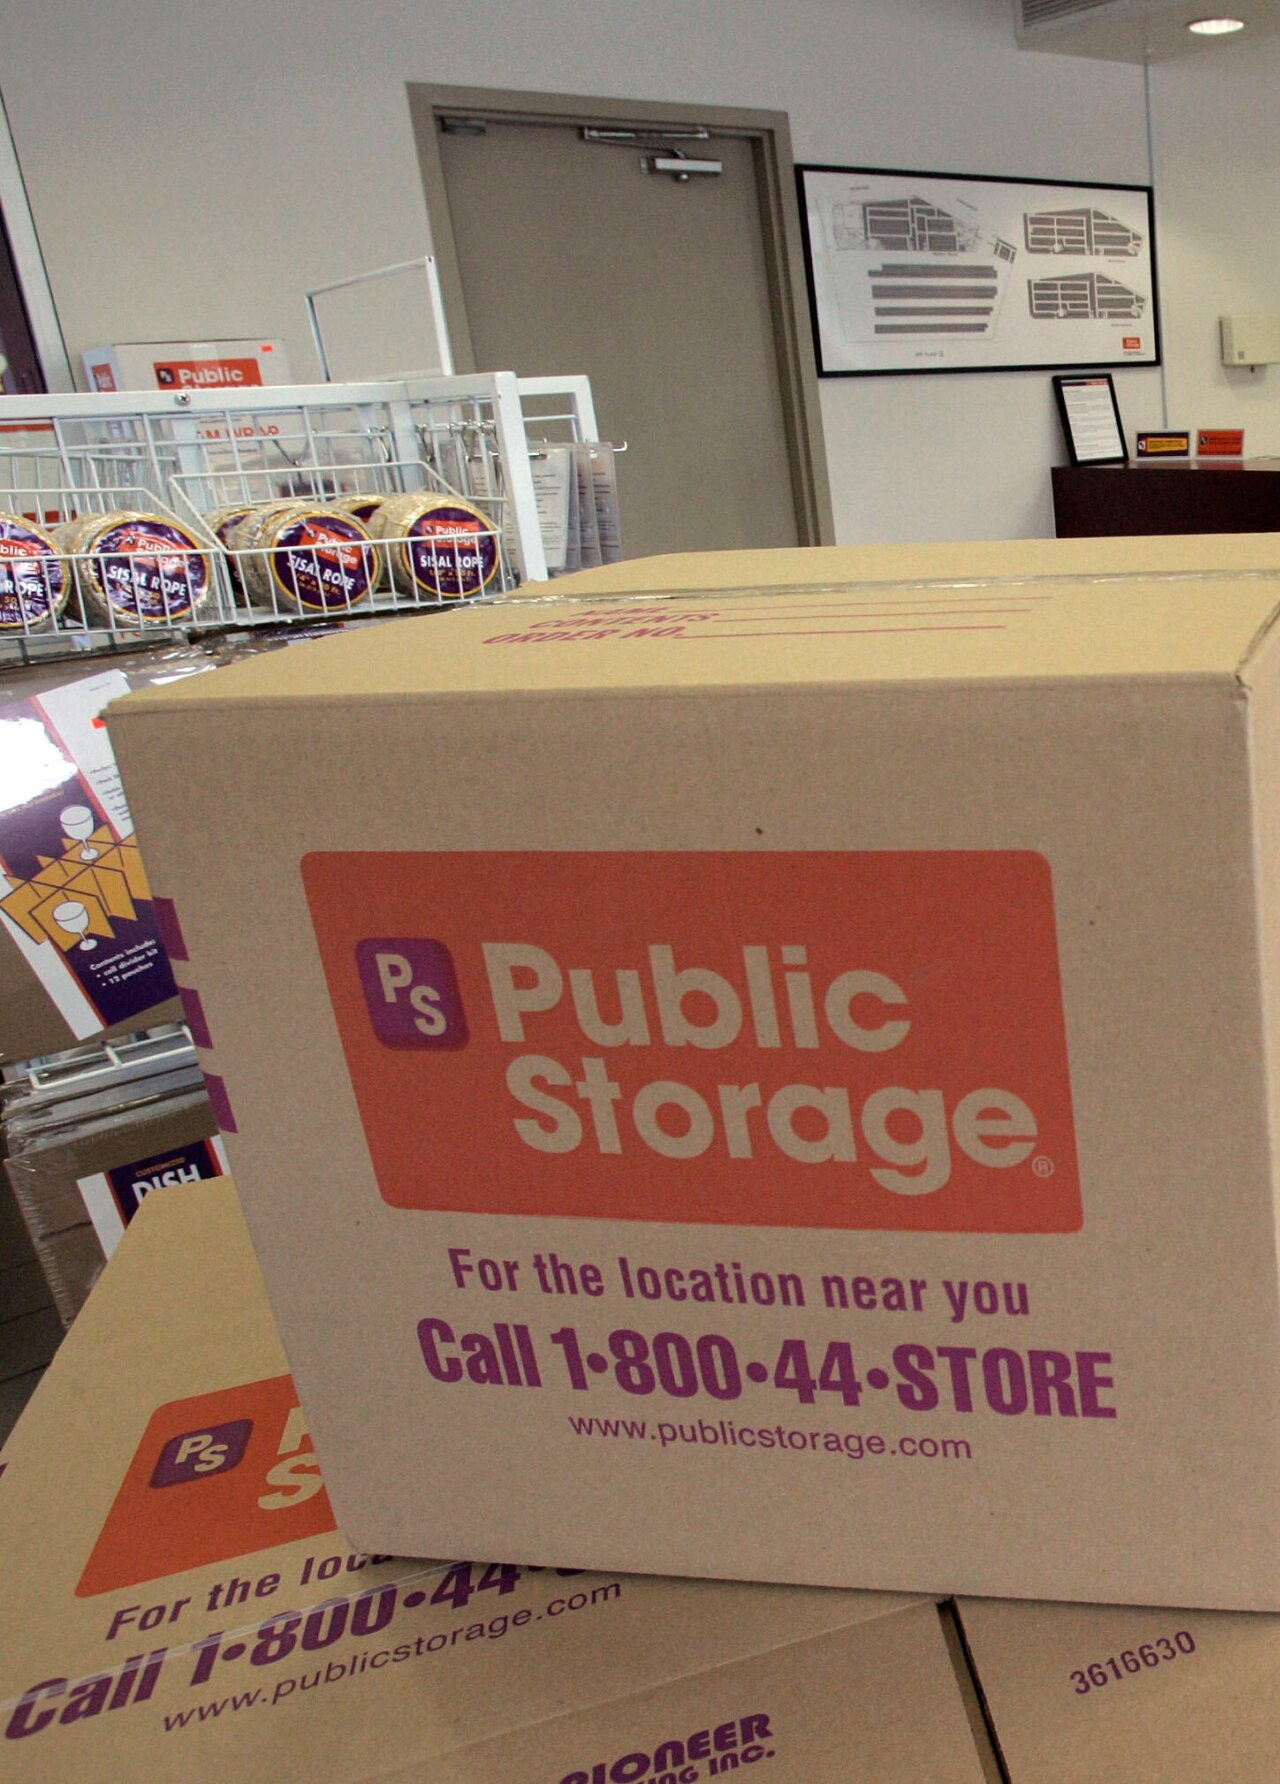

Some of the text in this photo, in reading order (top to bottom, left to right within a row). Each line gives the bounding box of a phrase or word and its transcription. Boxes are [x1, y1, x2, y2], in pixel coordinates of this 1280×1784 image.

[178, 366, 244, 384] Public
[0, 544, 28, 557] blic
[420, 555, 485, 569] SISAL ROPE
[5, 579, 44, 597] ROPE
[150, 575, 187, 596] ROPE
[482, 628, 621, 645] ORDER
[529, 612, 721, 629] CONTENTS
[90, 953, 125, 971] Contents
[374, 952, 447, 1037] PS
[480, 941, 911, 1054] Public
[503, 1054, 1038, 1196] Storage
[131, 1163, 201, 1204] DISH
[447, 1247, 1030, 1323] For the location near you
[415, 1317, 542, 1389] Call
[174, 1434, 229, 1472] PS
[568, 1415, 973, 1460] www.publicstorage.com
[105, 1598, 192, 1641] For
[207, 1576, 279, 1612] the
[163, 1582, 622, 1733] www.publicstorage.com
[1069, 1630, 1197, 1695] 3616630
[4, 1647, 168, 1740] Call
[708, 1745, 777, 1777] INC.
